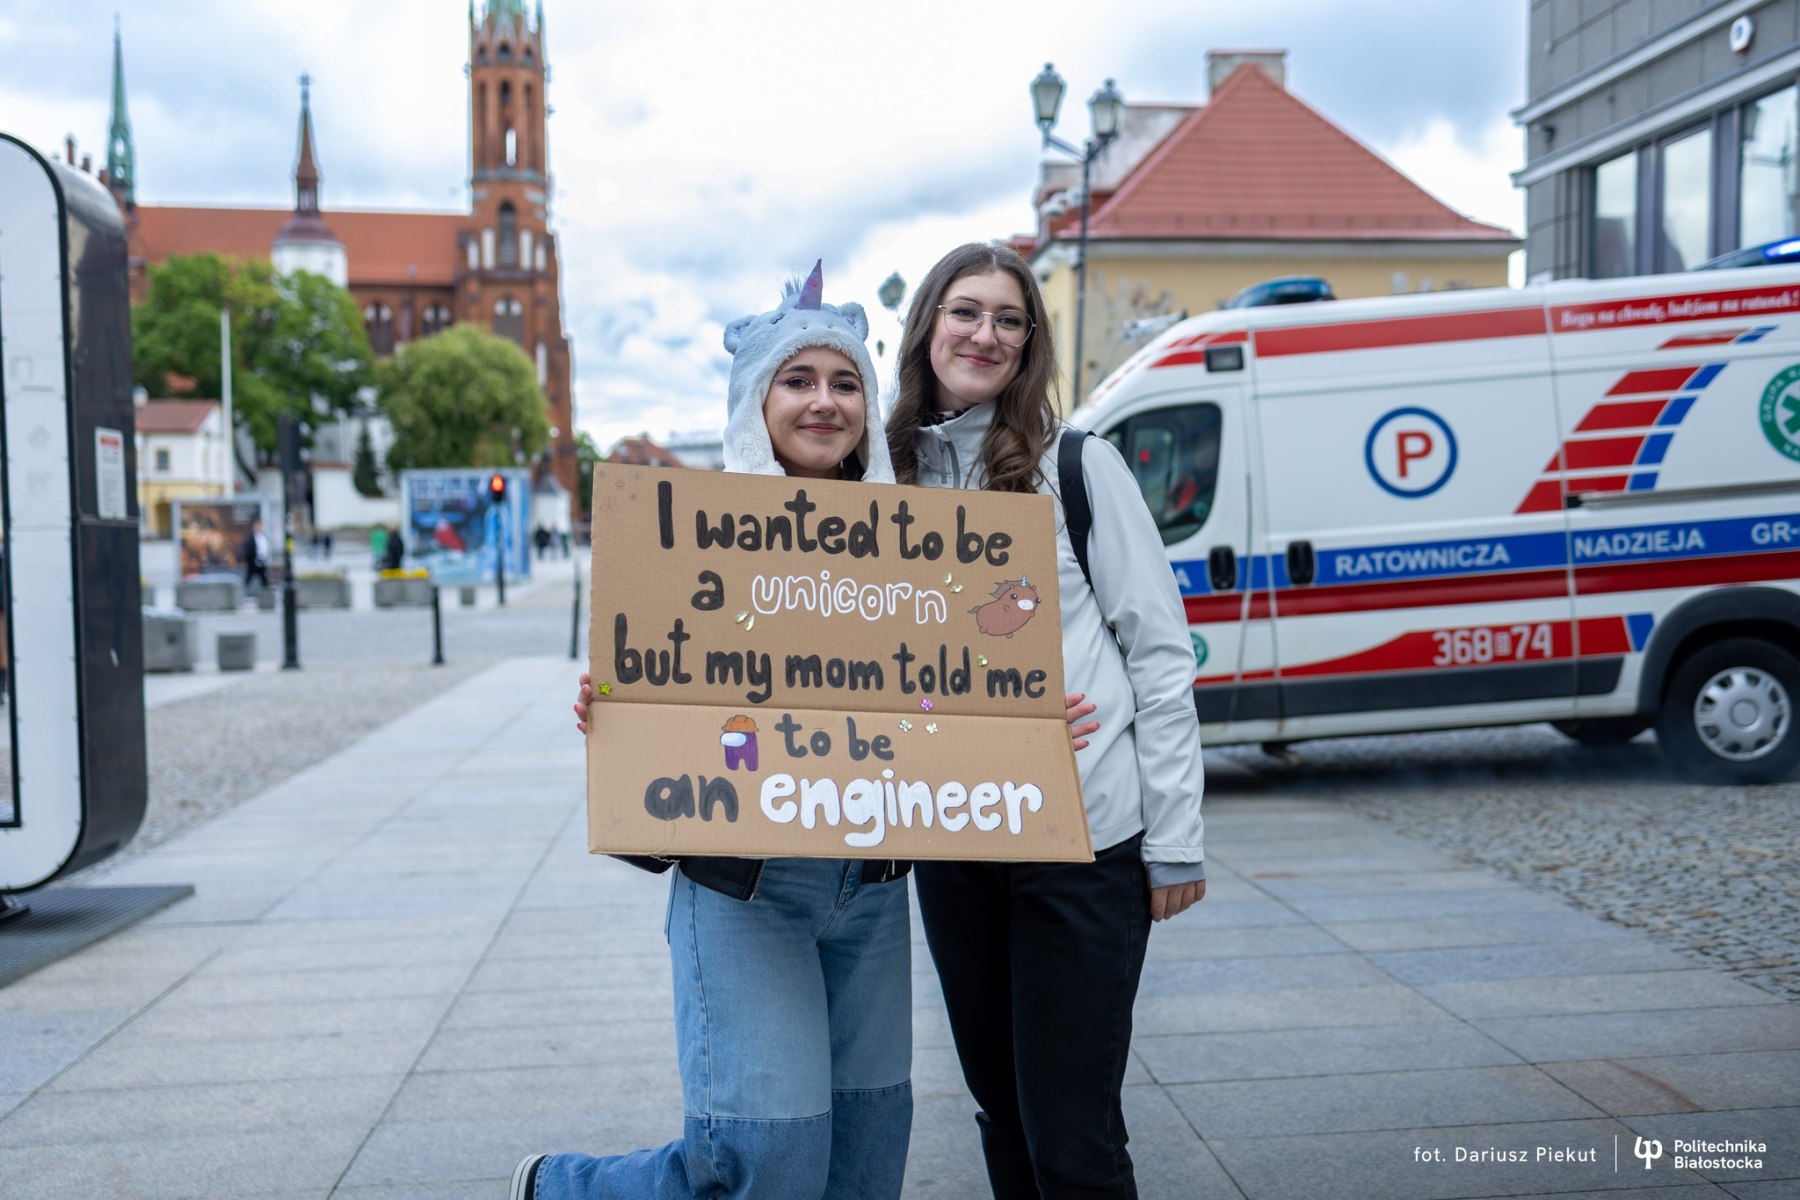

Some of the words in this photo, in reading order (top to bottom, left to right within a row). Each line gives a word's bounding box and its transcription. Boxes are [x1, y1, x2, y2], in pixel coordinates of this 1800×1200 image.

[1396, 431, 1433, 478] P
[657, 480, 675, 550] I
[695, 488, 879, 559] wanted
[890, 500, 944, 561] to
[956, 505, 1013, 567] be
[1335, 543, 1511, 577] RATOWNICZA
[1575, 528, 1706, 558] NADZIEJA
[690, 570, 725, 611] a
[751, 569, 948, 625] unicorn
[614, 612, 693, 687] but
[705, 649, 773, 705] my
[785, 654, 884, 691] mom
[891, 642, 972, 697] told
[986, 667, 1047, 699] me
[774, 713, 831, 758] to
[847, 716, 895, 761] be
[643, 773, 740, 822] an
[759, 768, 1044, 848] engineer
